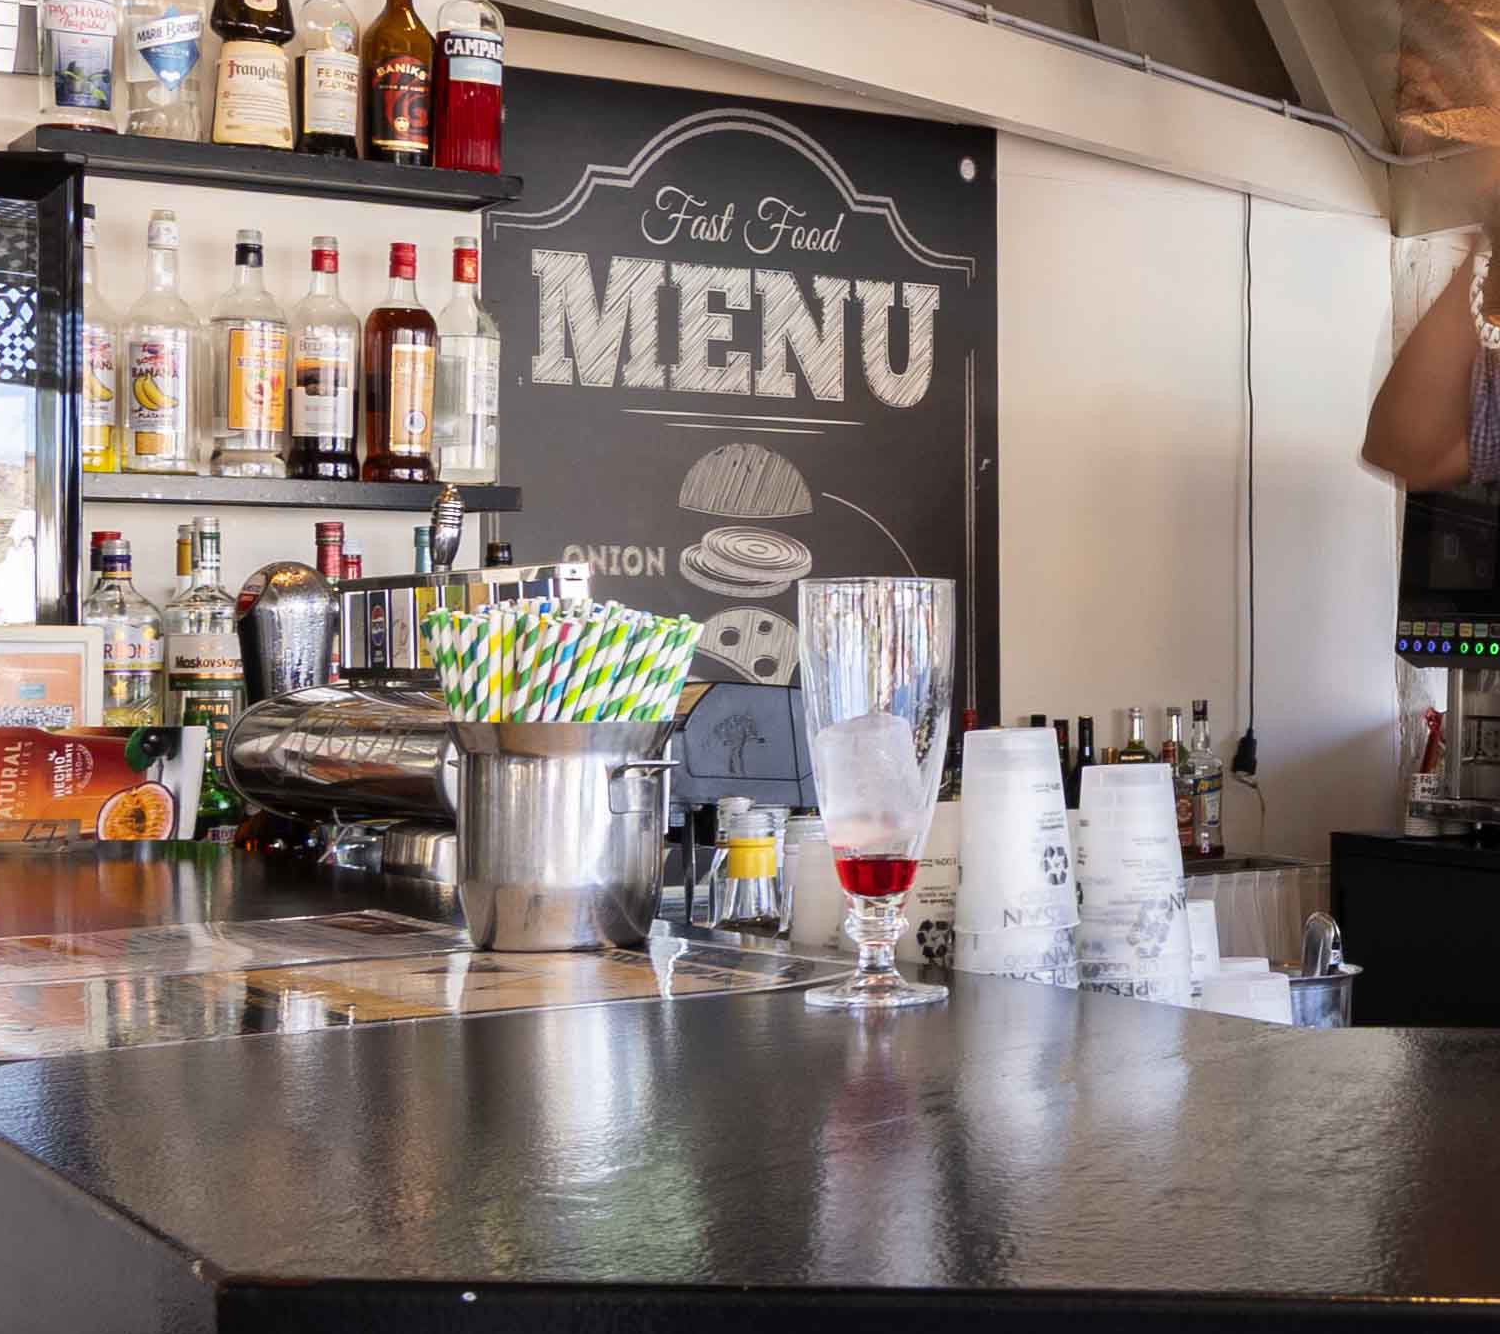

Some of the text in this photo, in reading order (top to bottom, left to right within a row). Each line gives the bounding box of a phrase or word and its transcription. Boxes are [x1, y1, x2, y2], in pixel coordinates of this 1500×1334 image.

[316, 67, 357, 82] FERNE
[640, 184, 845, 255] Fast Food
[530, 248, 941, 409] MENU
[131, 366, 180, 379] BANAA
[562, 543, 667, 577] ONION
[194, 703, 230, 716] ODKA
[52, 756, 67, 798] HECHO
